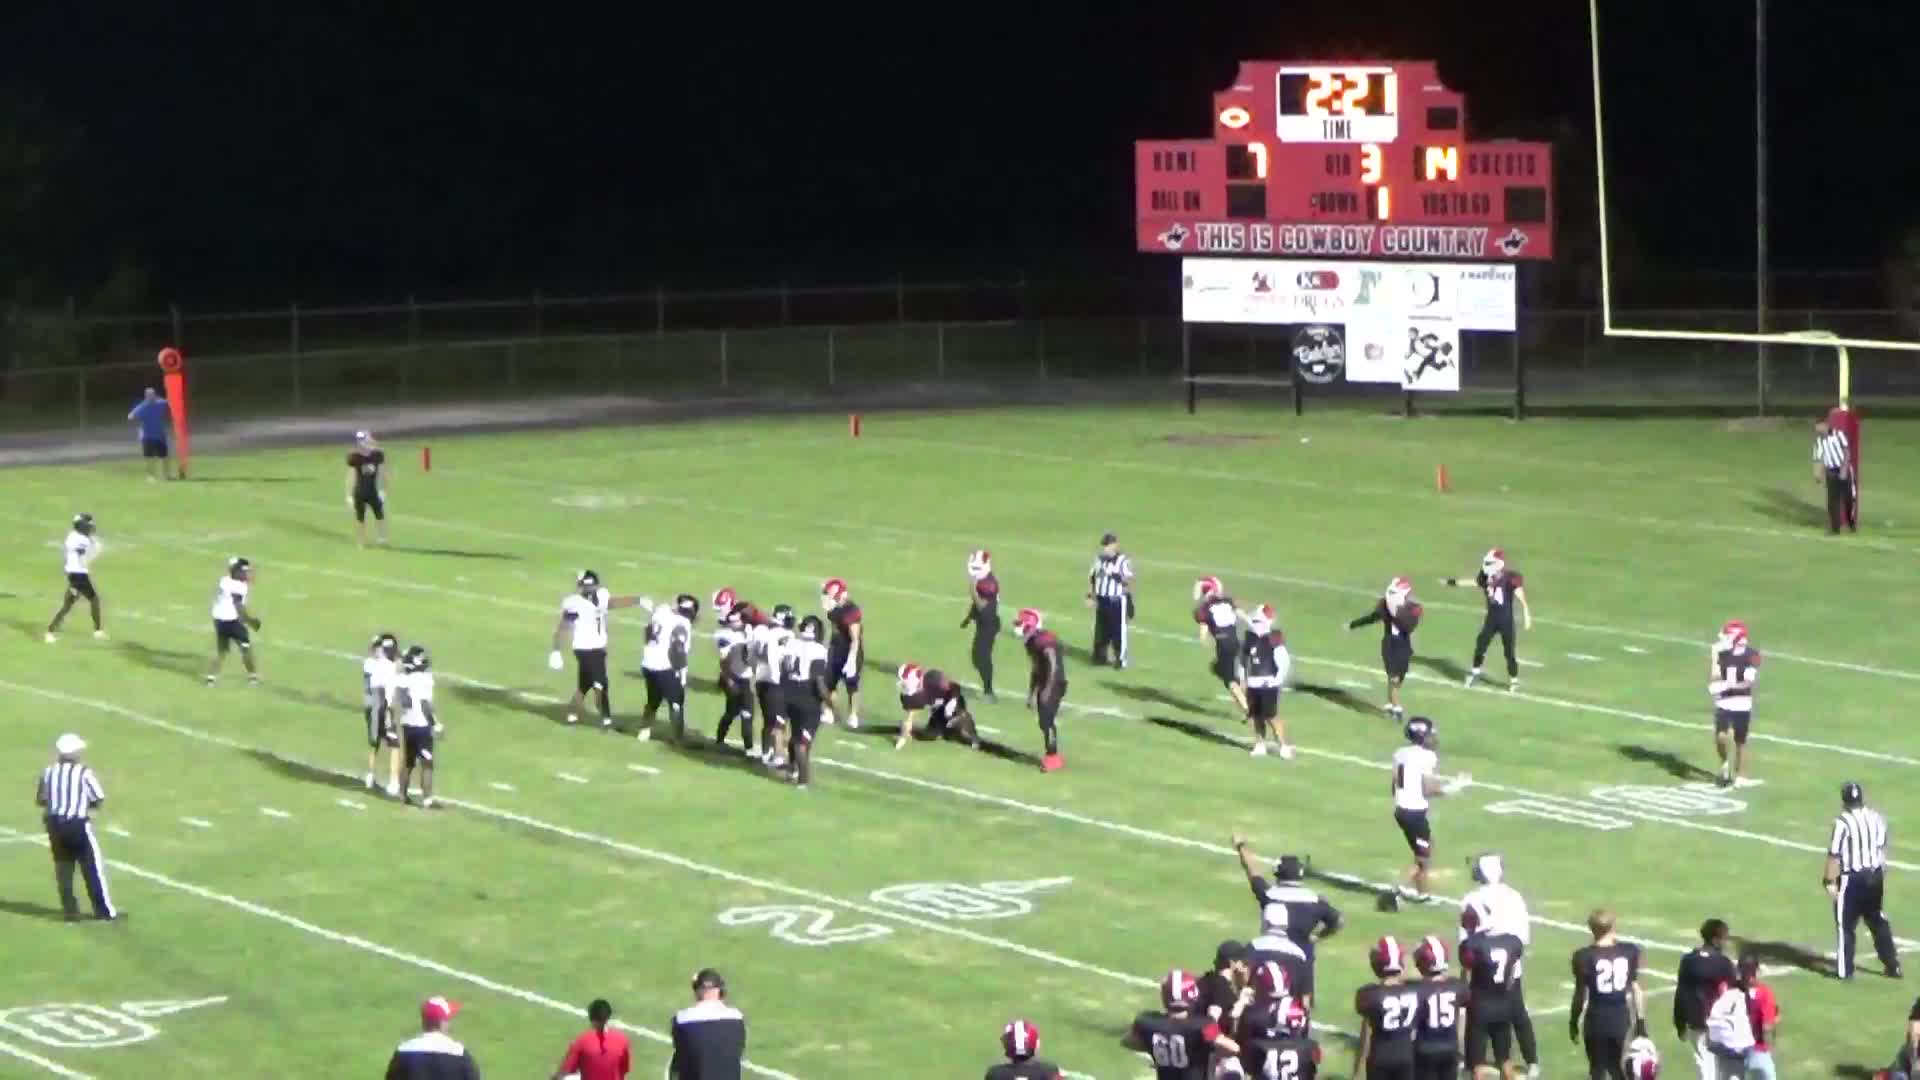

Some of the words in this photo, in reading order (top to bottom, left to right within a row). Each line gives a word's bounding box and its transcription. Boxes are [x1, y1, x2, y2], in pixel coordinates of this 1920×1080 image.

[1306, 73, 1394, 115] 2:21
[1323, 119, 1352, 139] TIME
[1247, 142, 1267, 178] 7
[1361, 143, 1381, 183] 3
[1377, 186, 1389, 220] 1
[1195, 223, 1245, 251] THIS
[1250, 223, 1273, 251] IS
[1279, 223, 1375, 254] COWBOY
[1380, 226, 1488, 256] COUNTRY
[1489, 947, 1508, 984] 7
[1382, 992, 1418, 1030] 27
[1427, 991, 1457, 1029] 15
